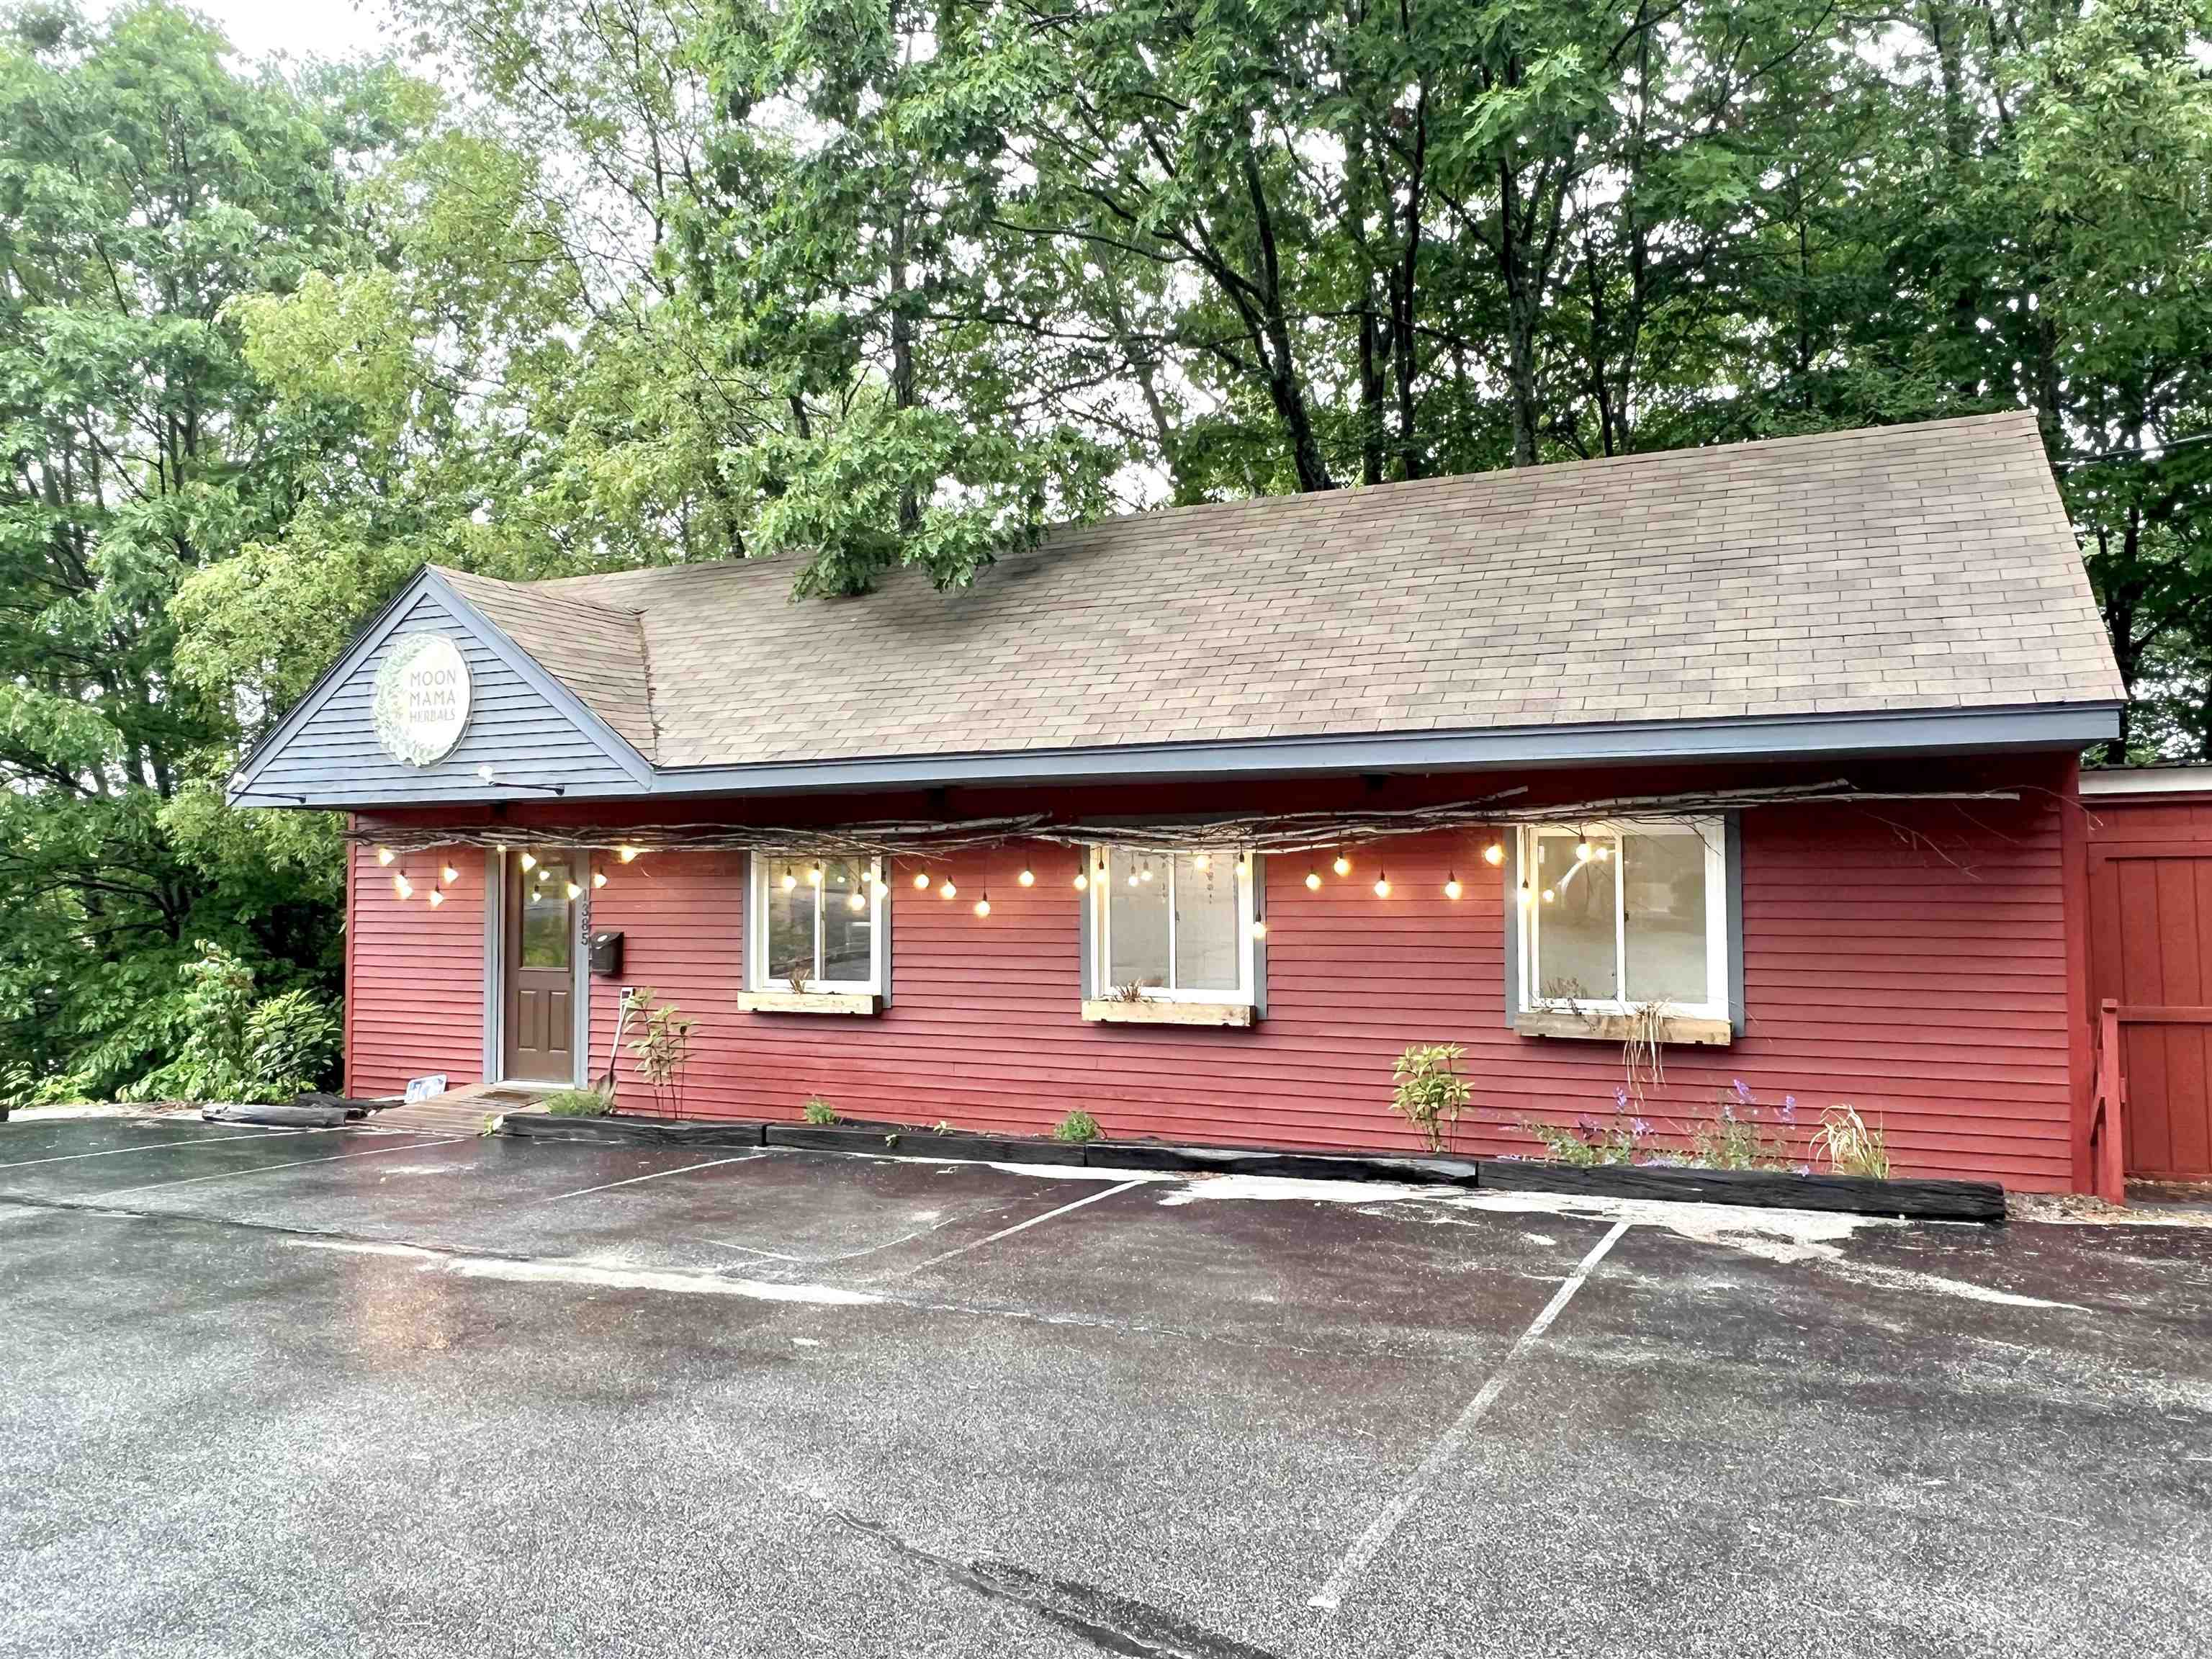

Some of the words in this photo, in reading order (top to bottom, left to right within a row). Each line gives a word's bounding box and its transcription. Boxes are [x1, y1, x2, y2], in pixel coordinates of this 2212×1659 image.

[410, 670, 456, 687] MOON
[410, 689, 456, 706] MAMA
[409, 709, 456, 723] HERBALS
